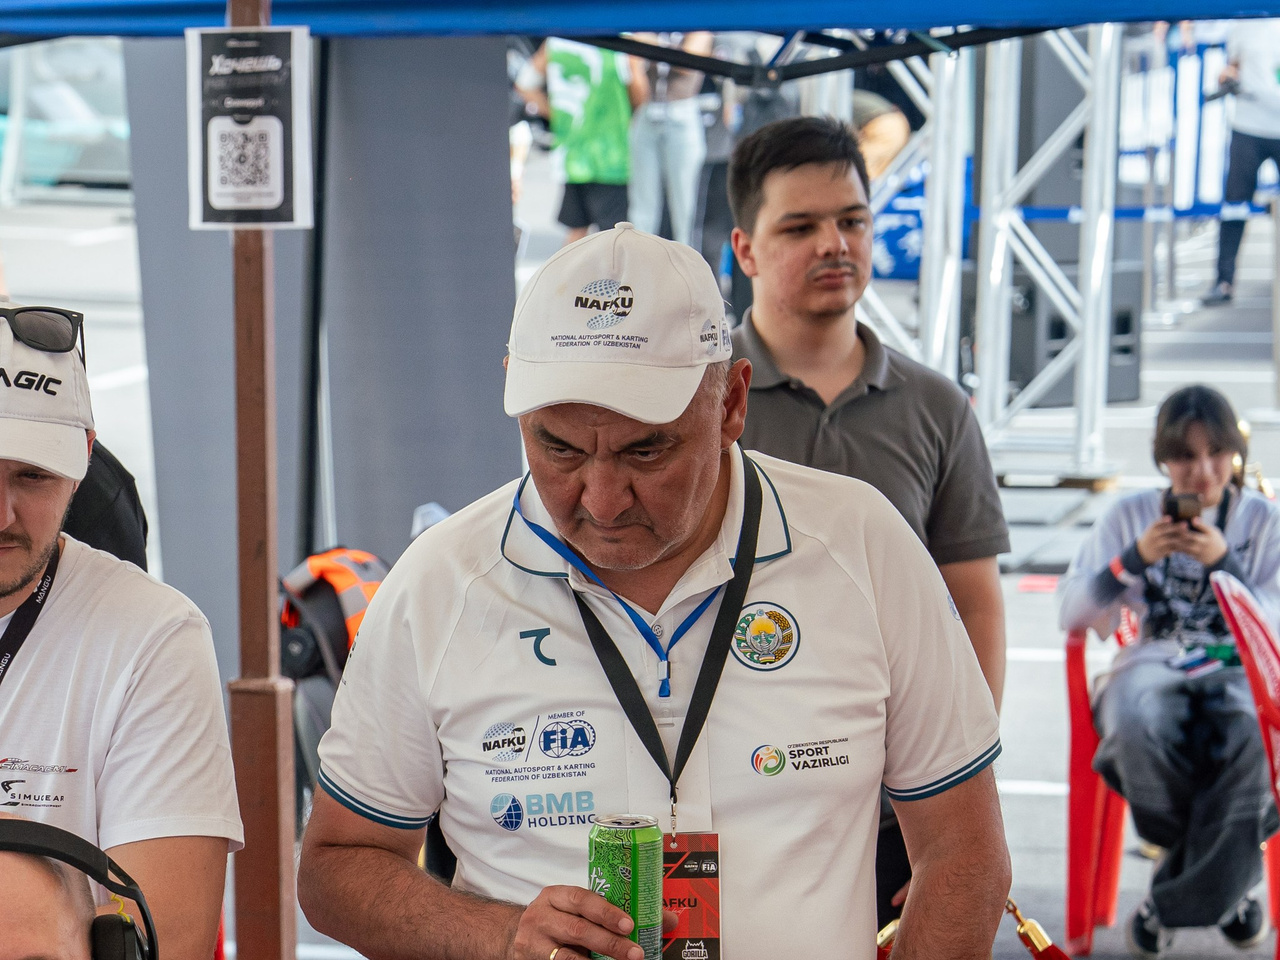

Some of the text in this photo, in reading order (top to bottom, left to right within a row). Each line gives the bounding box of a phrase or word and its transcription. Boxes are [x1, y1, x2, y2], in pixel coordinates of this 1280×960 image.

[574, 296, 634, 312] NAFKU
[550, 334, 578, 342] NATIONAL
[578, 333, 615, 341] AUTOSPORT
[621, 334, 649, 343] KARTING
[555, 340, 591, 348] FEDERATION
[602, 340, 641, 349] UZBEKISTAN
[35, 575, 52, 604] MANGU
[547, 711, 574, 720] MEMBER
[482, 735, 526, 752] NAFKU
[789, 746, 829, 759] SPORT
[513, 765, 555, 773] AUTOSPORT
[564, 762, 596, 770] KARTING
[792, 755, 850, 771] VAZIRLIGI
[491, 774, 530, 782] FEDERATION
[542, 771, 587, 779] UZBEKISTAN
[526, 790, 595, 816] BMB
[663, 897, 698, 908] AFKU
